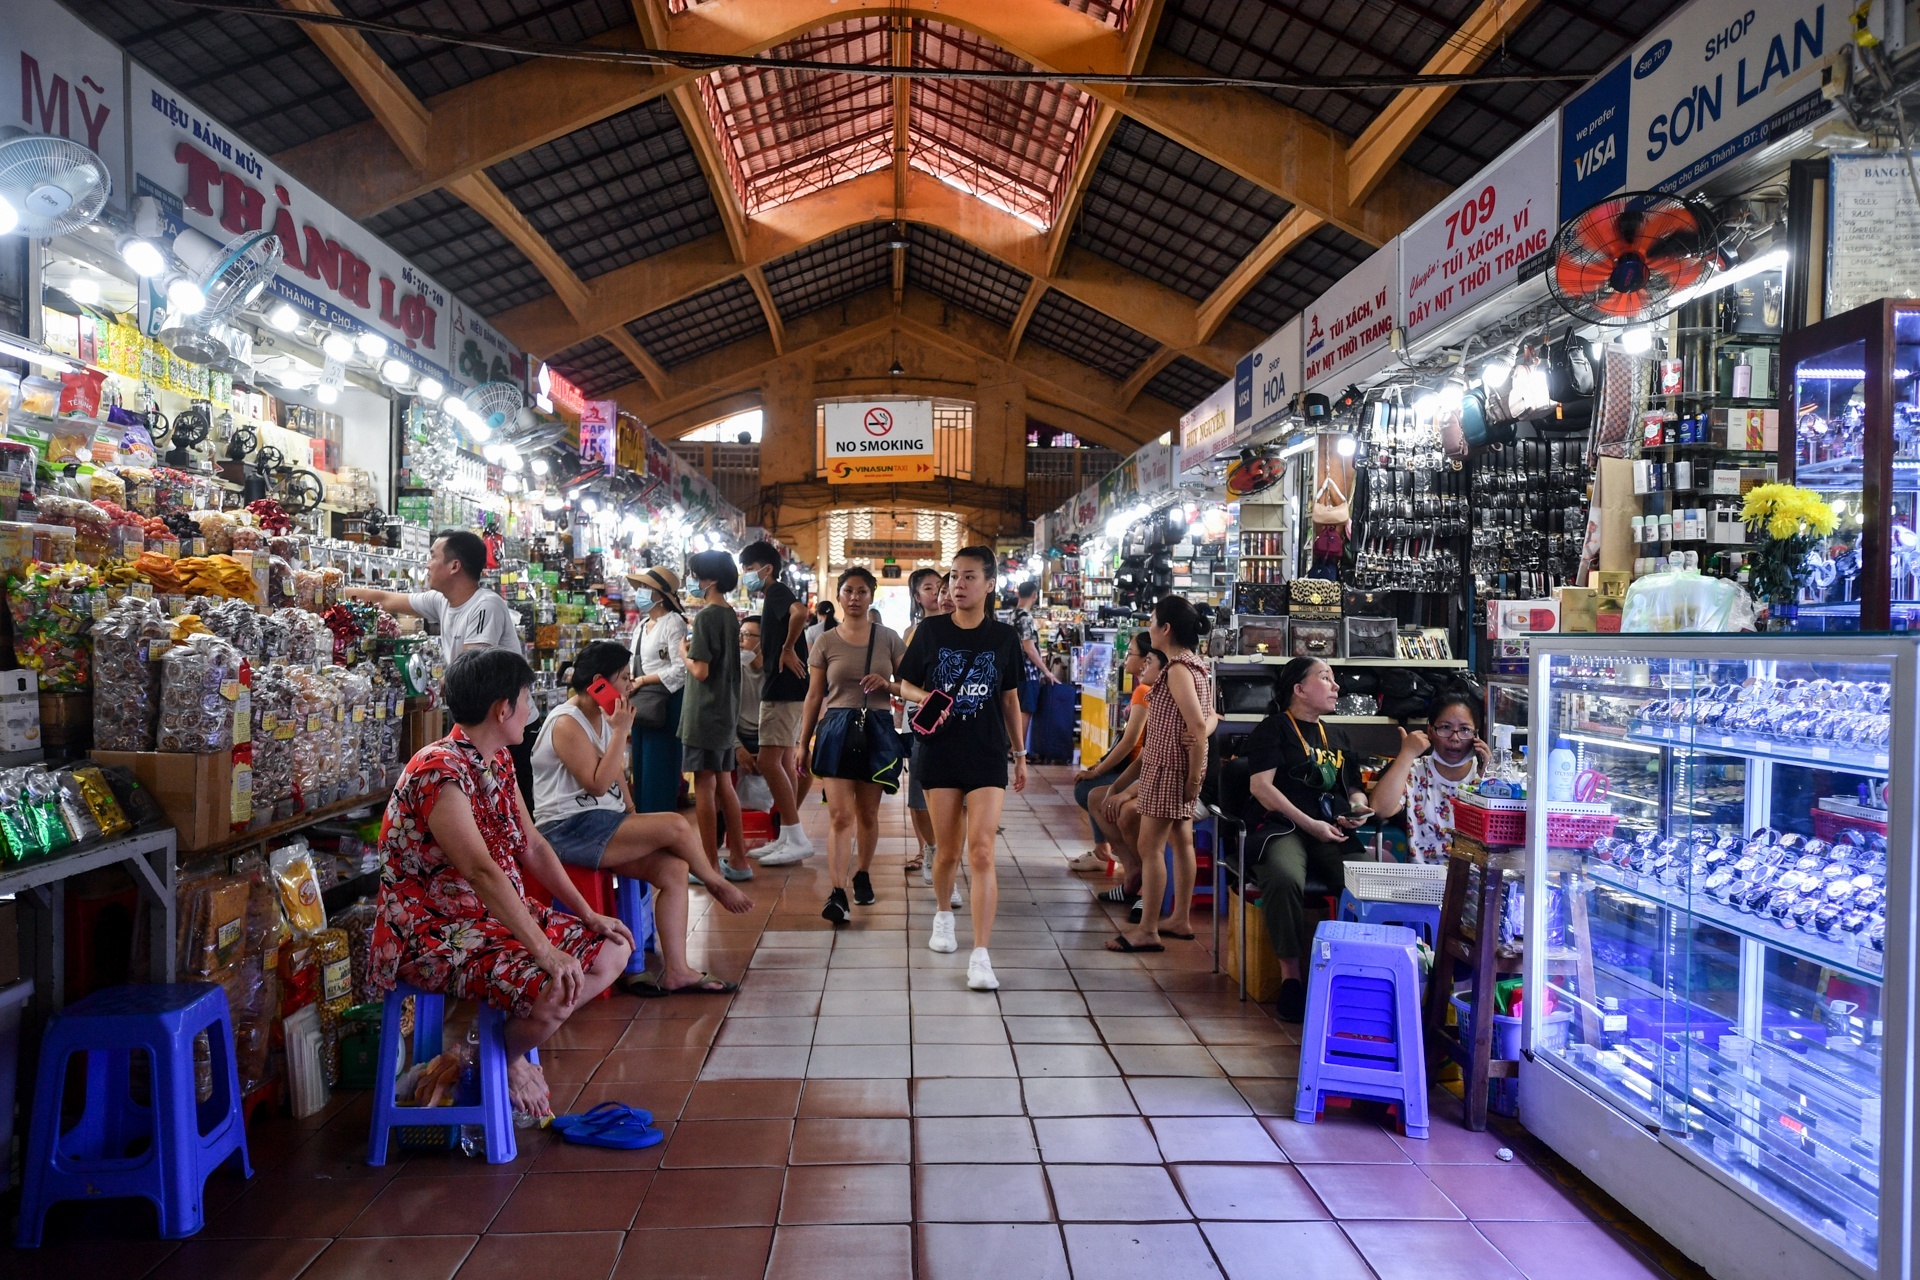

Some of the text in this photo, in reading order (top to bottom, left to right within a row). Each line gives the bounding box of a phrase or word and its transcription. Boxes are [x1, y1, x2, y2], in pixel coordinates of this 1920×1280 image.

[1639, 45, 1666, 73] Sạp 707
[1704, 9, 1756, 62] SHOP
[20, 50, 111, 154] MỸ
[1646, 3, 1825, 162] SƠN LAN
[151, 89, 189, 129] HIỆU
[192, 121, 232, 160] BÁNH
[1575, 105, 1616, 141] we prefer
[1573, 133, 1617, 182] VISA
[1678, 170, 1693, 187] chợ
[1693, 159, 1709, 175] Bến
[1710, 144, 1736, 169] Thành
[1743, 130, 1759, 148] ĐT:
[1864, 164, 1898, 178] BẢNG
[1441, 248, 1463, 280] TÚI
[1466, 223, 1511, 266] XÁCH,
[1513, 198, 1532, 233] VÍ
[1445, 185, 1497, 251] 709
[175, 141, 438, 351] THÀNH LỢI
[279, 283, 315, 310] THÀNH
[1408, 299, 1432, 329] DÂY
[1434, 284, 1454, 312] NỊT
[1458, 261, 1491, 297] THỜI
[1494, 228, 1548, 275] TRANG
[1329, 285, 1387, 341] TÚI XÁCH, VÍ
[1268, 357, 1280, 373] SHOP
[1306, 360, 1321, 381] DÂY
[1322, 350, 1336, 371] NỊT
[1337, 335, 1358, 361] THỜI
[1359, 314, 1393, 348] TRANG
[1238, 388, 1251, 408] VISA
[1263, 371, 1286, 409] HOA
[581, 424, 606, 437] SẠP
[836, 439, 924, 453] NO SMOKING
[1186, 426, 1199, 450] HUY
[944, 683, 989, 696] KNZO
